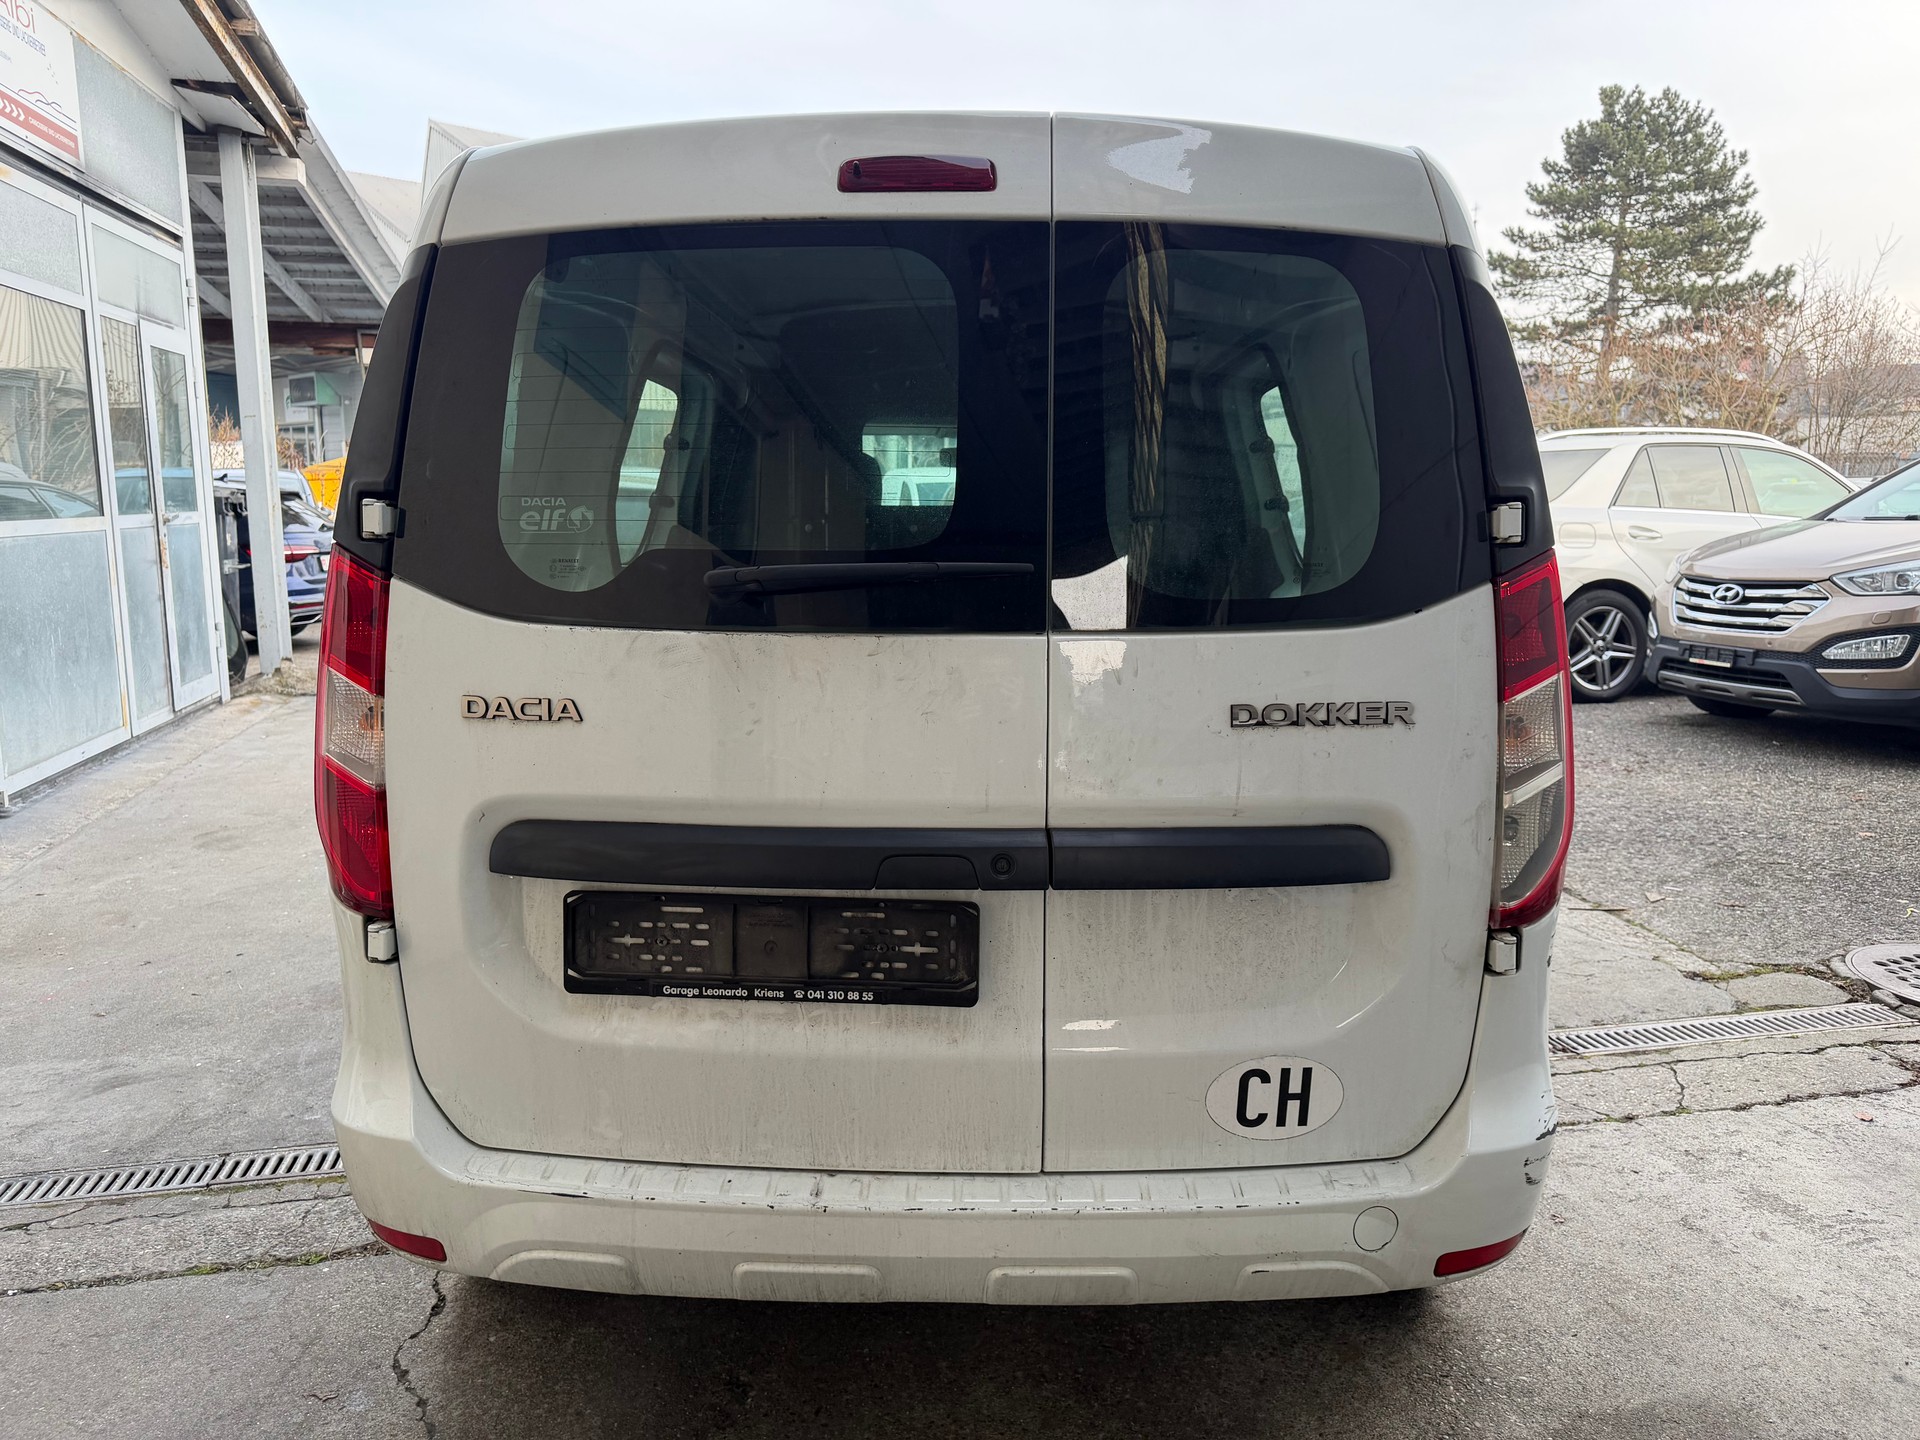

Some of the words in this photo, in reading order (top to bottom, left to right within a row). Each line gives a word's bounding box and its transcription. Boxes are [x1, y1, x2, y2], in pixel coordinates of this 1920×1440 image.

[521, 497, 567, 506] DACIA
[520, 508, 567, 531] elf
[461, 694, 583, 722] DACIA
[1230, 701, 1416, 728] DOKKER
[662, 985, 700, 997] Garage
[702, 986, 748, 997] Leonardo
[754, 988, 785, 998] Kriens
[807, 989, 825, 999] 041
[827, 990, 845, 1000] 310
[847, 991, 860, 1001] 88
[862, 992, 874, 1001] 55
[1236, 1067, 1313, 1128] CH
